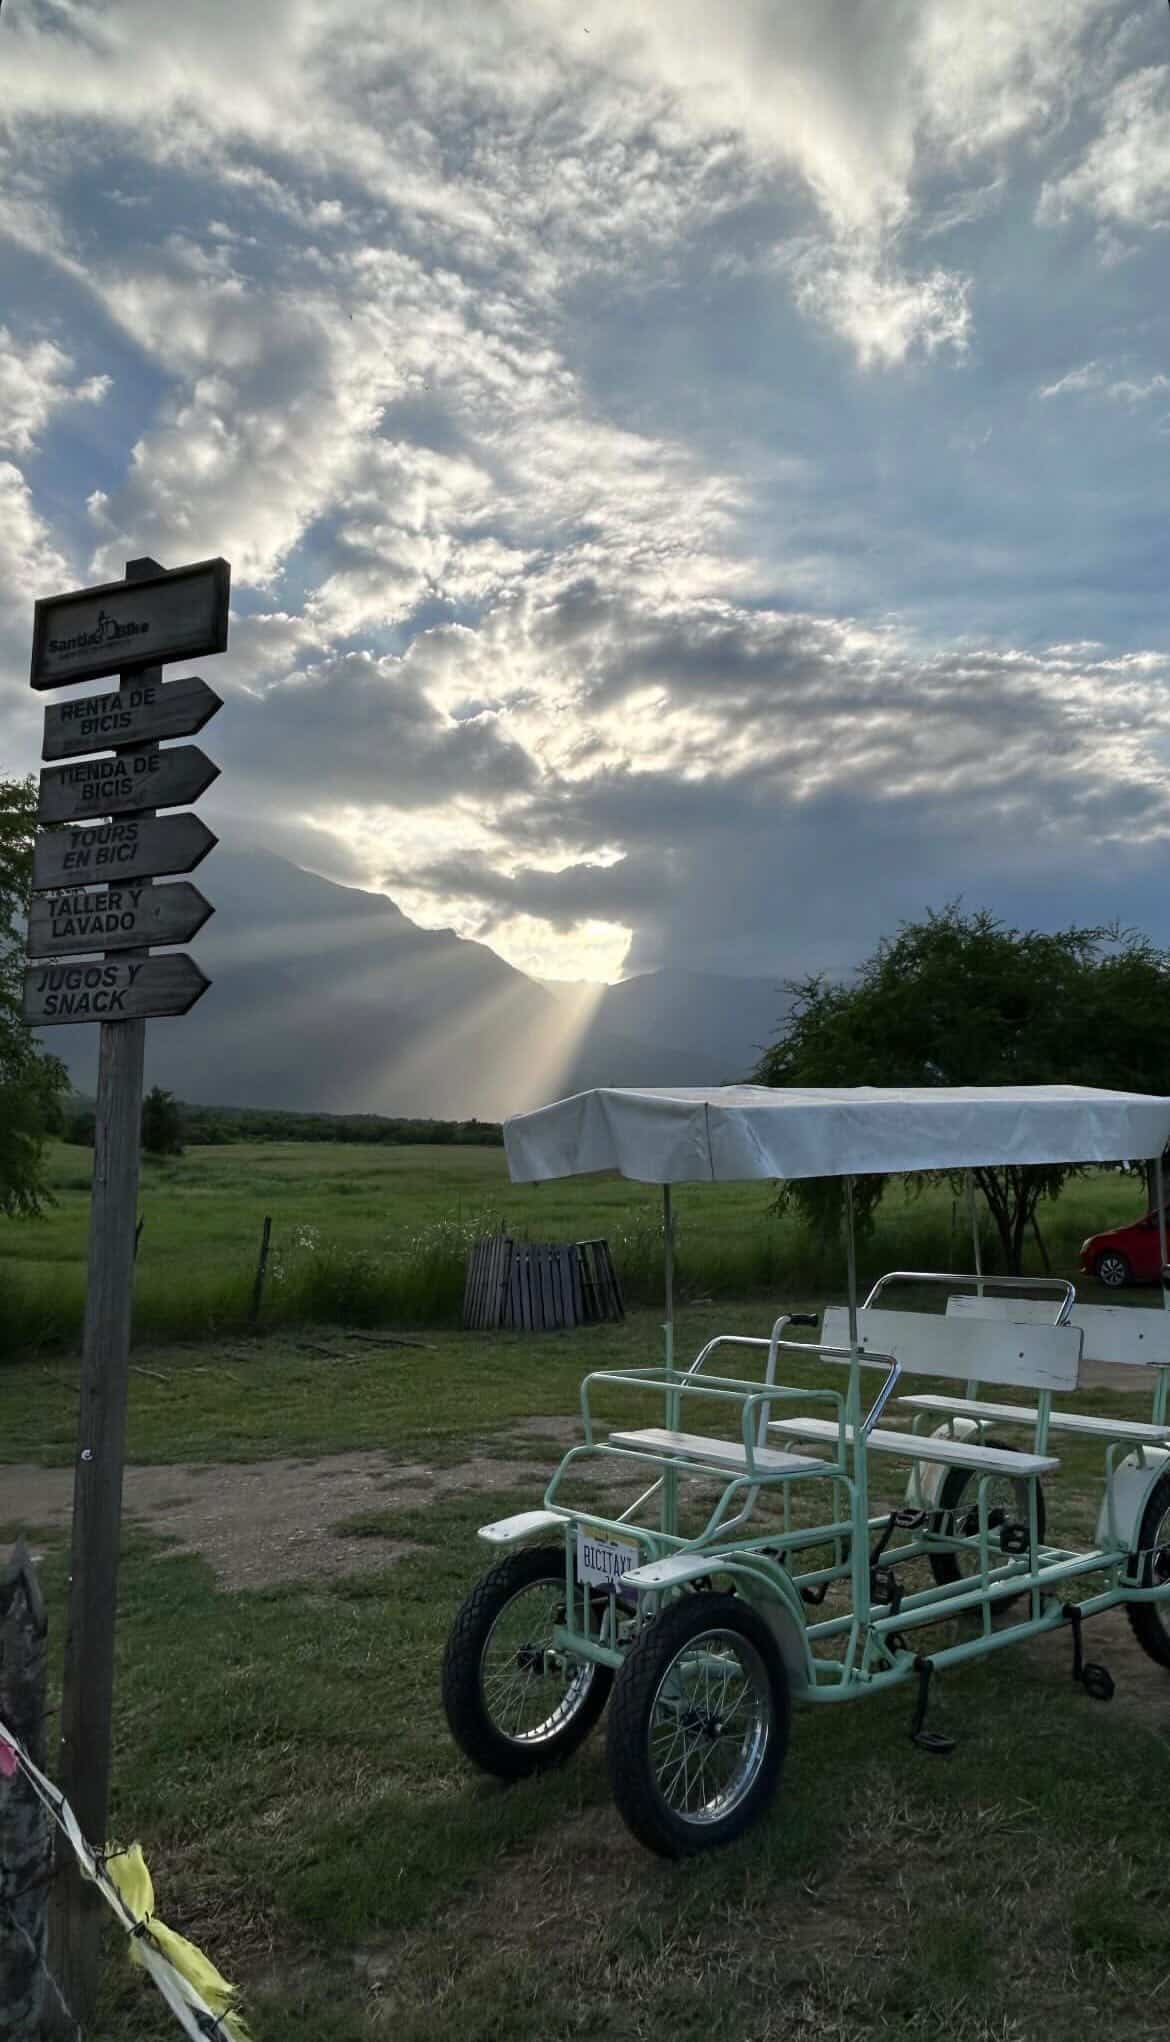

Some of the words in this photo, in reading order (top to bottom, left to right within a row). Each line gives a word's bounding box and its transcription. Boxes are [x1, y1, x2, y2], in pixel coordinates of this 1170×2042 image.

[61, 693, 122, 722] RENTA
[130, 688, 156, 707] DE
[80, 712, 132, 735] BICIS
[59, 759, 128, 785] TIENDA
[133, 755, 161, 773] DE
[82, 777, 133, 800] BICIS
[70, 823, 139, 849] TOURS
[62, 850, 89, 870] EN
[96, 842, 138, 865] BICI
[48, 891, 121, 918] TALLER
[129, 889, 144, 909] Y
[52, 912, 136, 938] LAVADO
[37, 966, 118, 993] JUGOS
[127, 964, 144, 985] Y
[42, 990, 129, 1016] SNACK
